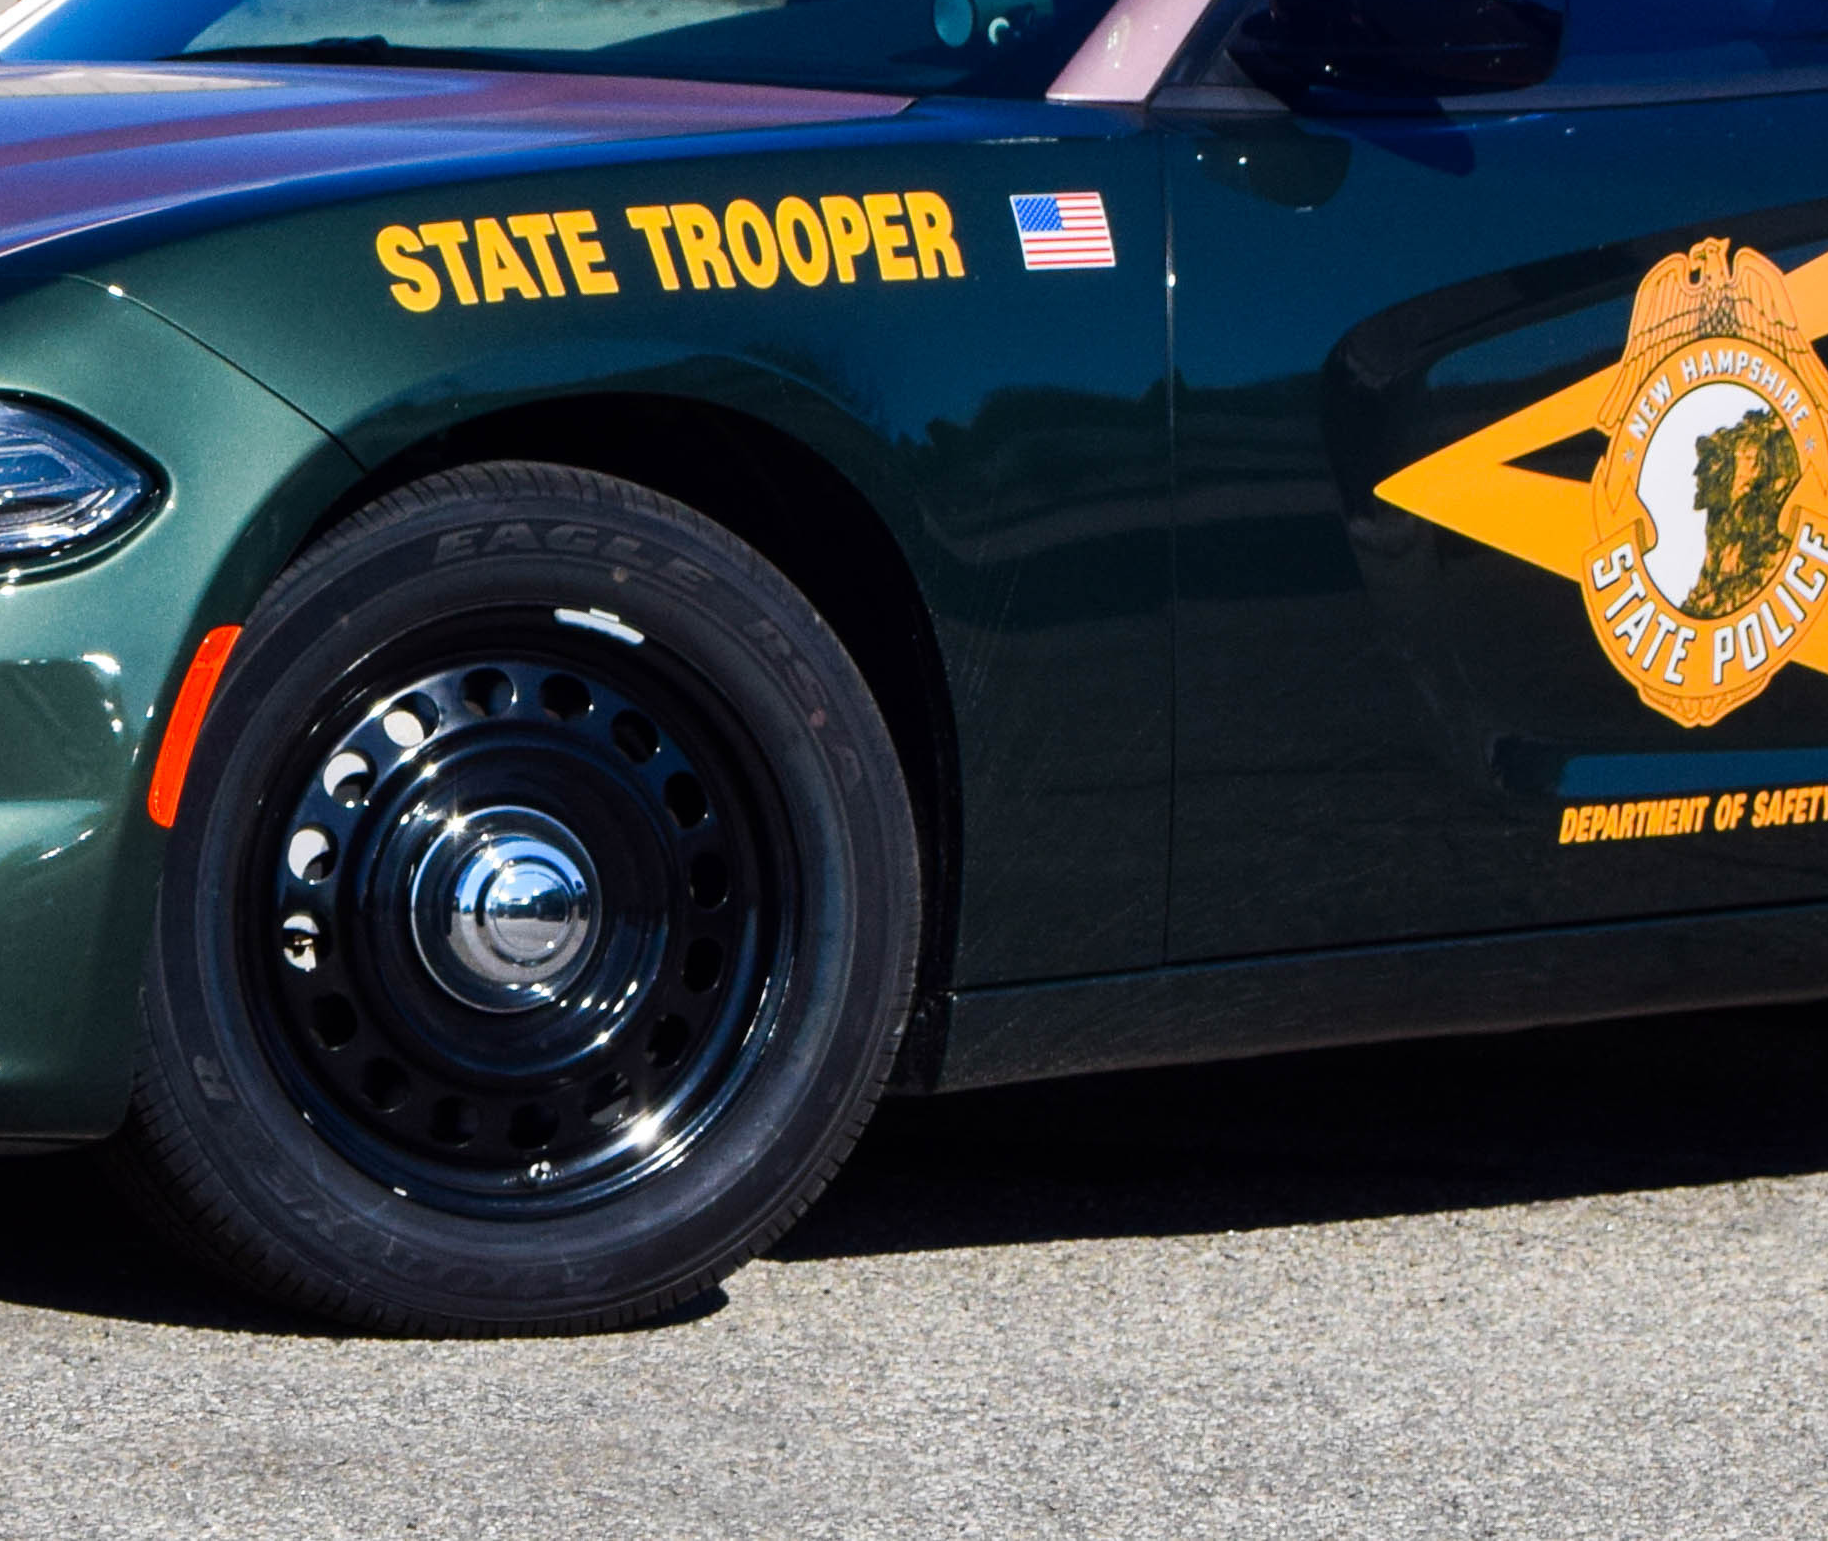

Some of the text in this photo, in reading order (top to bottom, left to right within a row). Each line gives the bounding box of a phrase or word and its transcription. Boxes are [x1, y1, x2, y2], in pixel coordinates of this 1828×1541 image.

[375, 191, 967, 314] STATE TROOPER
[1628, 349, 1810, 441] NEW HAMPSHIRE
[1591, 542, 1697, 686] STATE
[1559, 796, 1710, 845] DEPARTMENT
[1714, 793, 1748, 832] OF
